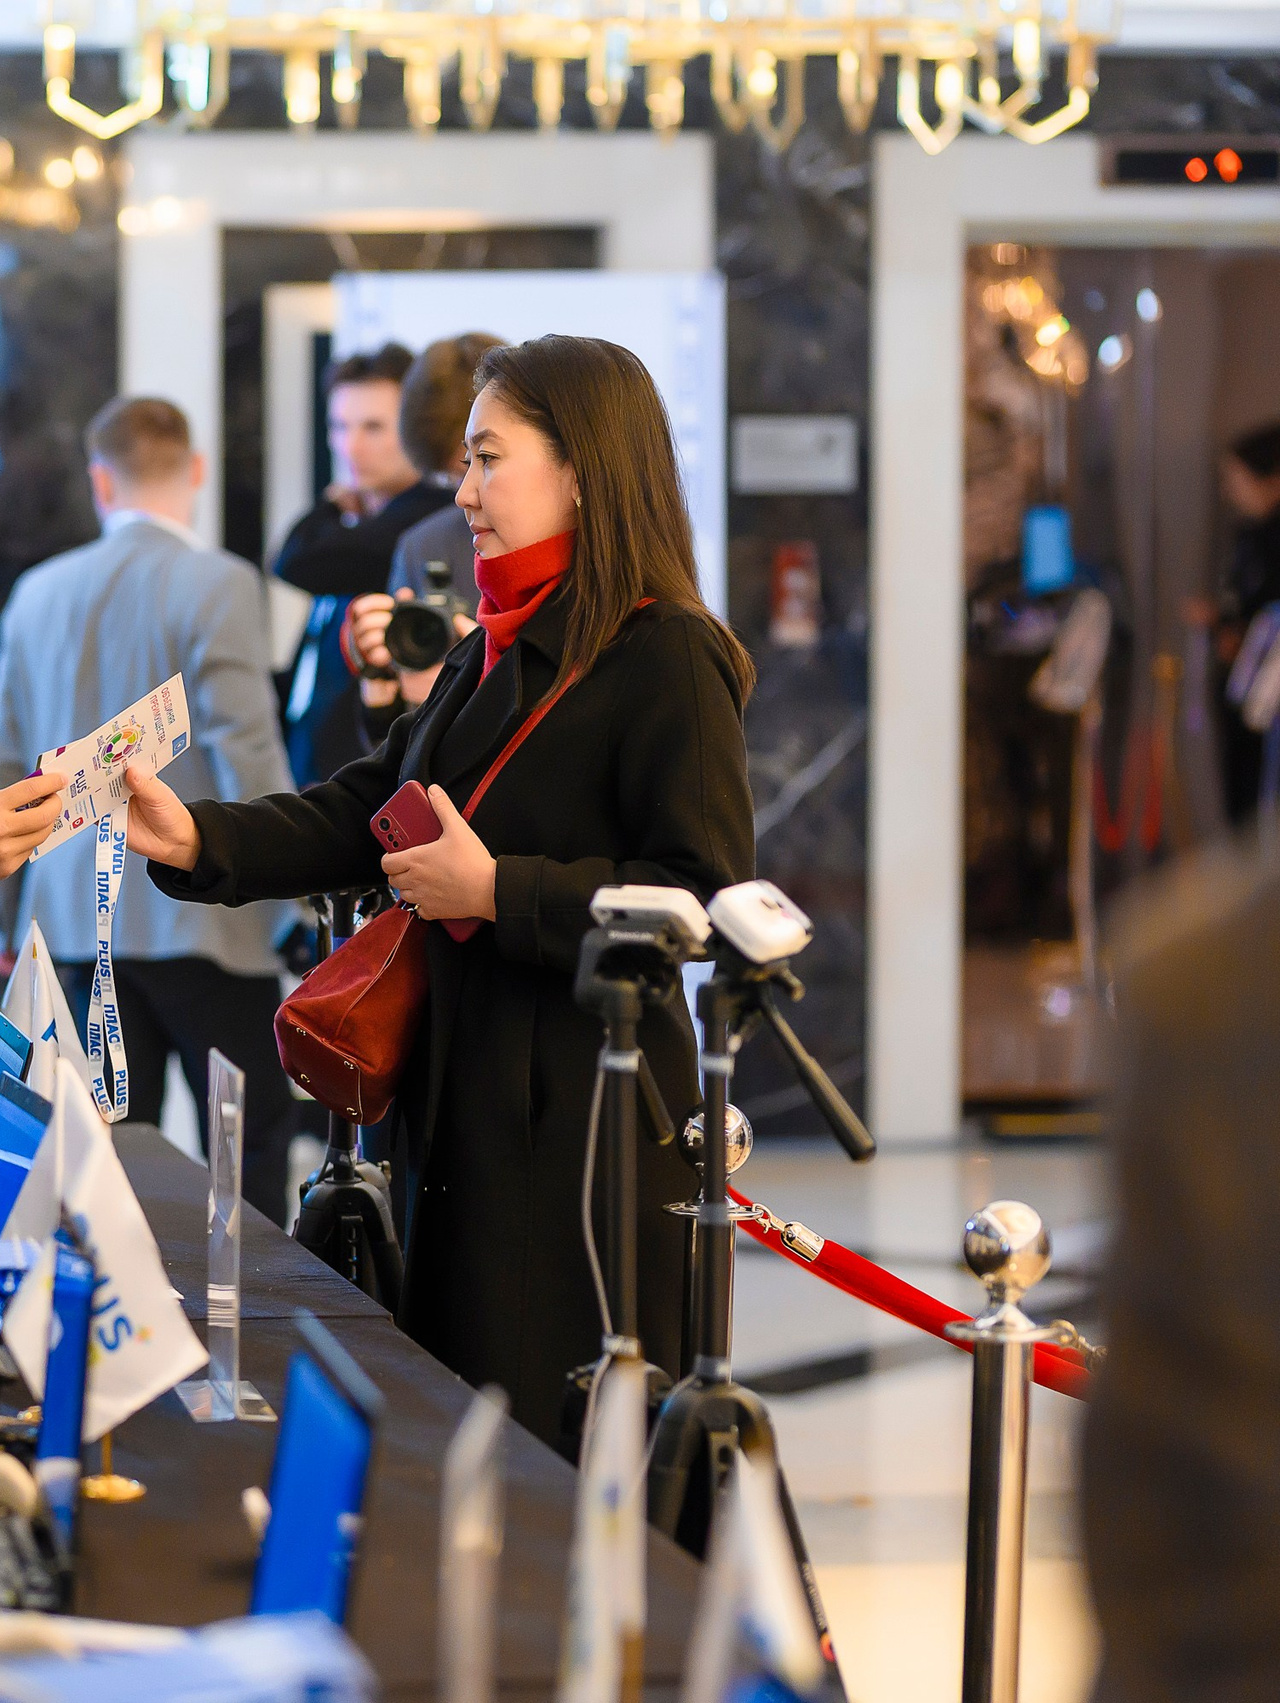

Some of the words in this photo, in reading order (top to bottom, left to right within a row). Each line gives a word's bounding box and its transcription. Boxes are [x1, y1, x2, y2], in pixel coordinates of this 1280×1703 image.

[150, 694, 166, 745] ПРЕИМУЩЕСТВА
[74, 769, 87, 794] PLUS
[99, 814, 111, 842] LUS
[113, 832, 125, 874] ПЛАС
[98, 872, 109, 913] ПЛАС
[99, 940, 111, 977] PLUS
[90, 1022, 101, 1056] ПЛАС
[104, 1004, 120, 1043] ПЛАС
[93, 1077, 111, 1114] PLUS
[116, 1070, 126, 1105] PLUS
